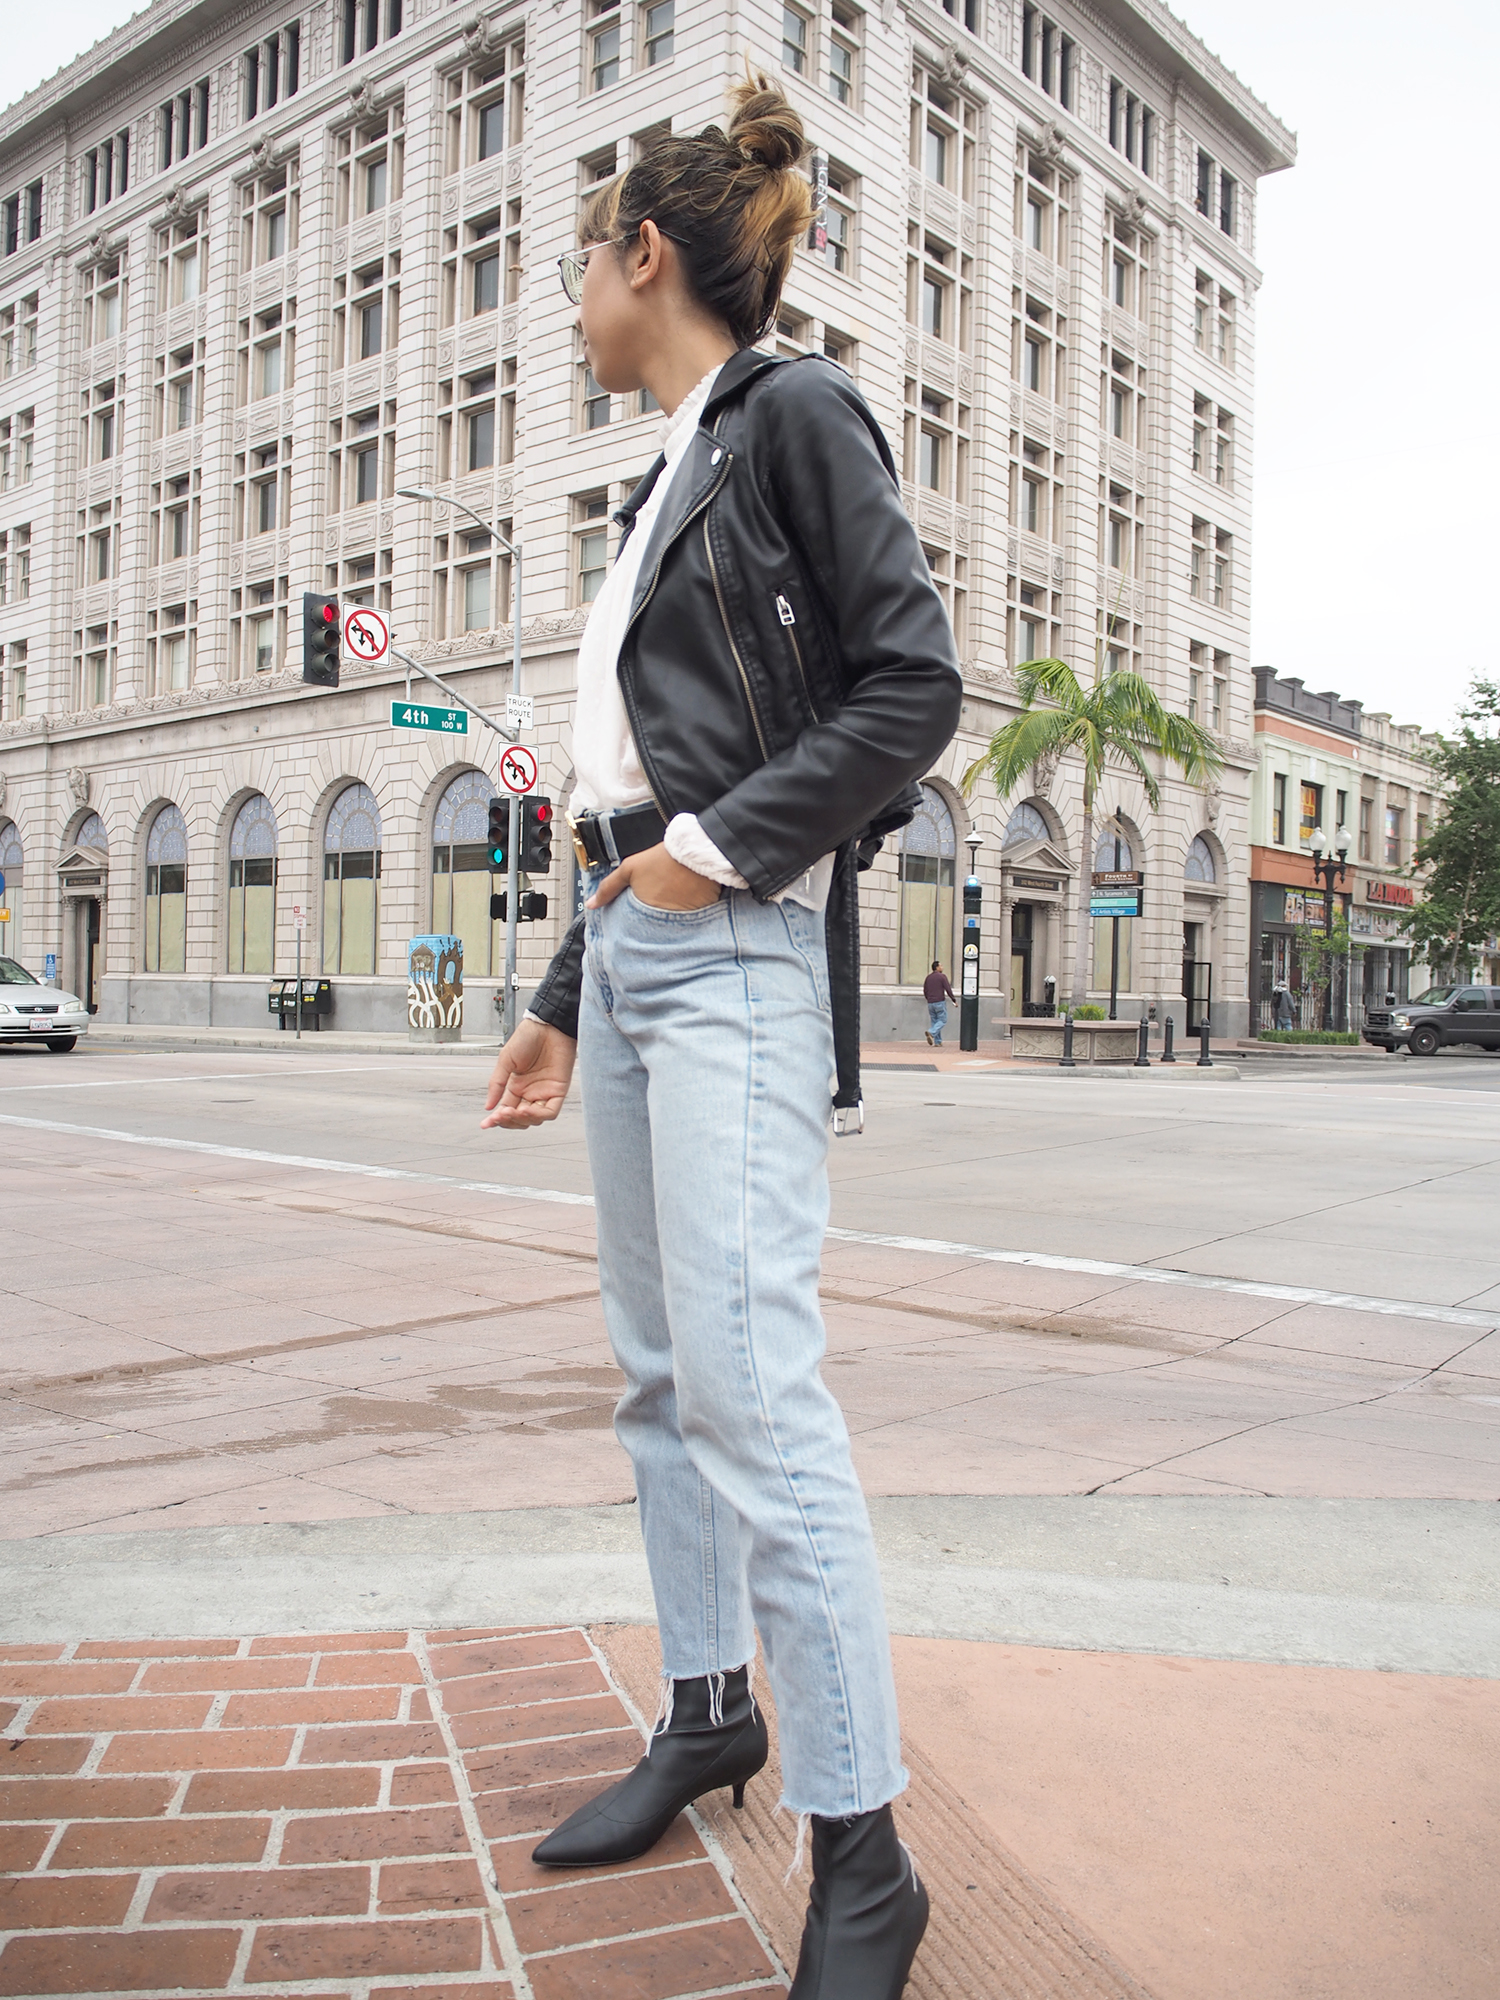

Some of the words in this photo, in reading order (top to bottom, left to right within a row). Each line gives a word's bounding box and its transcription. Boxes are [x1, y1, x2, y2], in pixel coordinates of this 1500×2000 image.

[508, 698, 531, 707] TRUCK
[402, 708, 429, 725] 4th
[447, 713, 456, 721] ST
[509, 709, 531, 718] ROUTE
[441, 721, 454, 729] 100
[456, 722, 463, 730] W
[1368, 881, 1384, 899] LA
[1385, 883, 1414, 905] MODA
